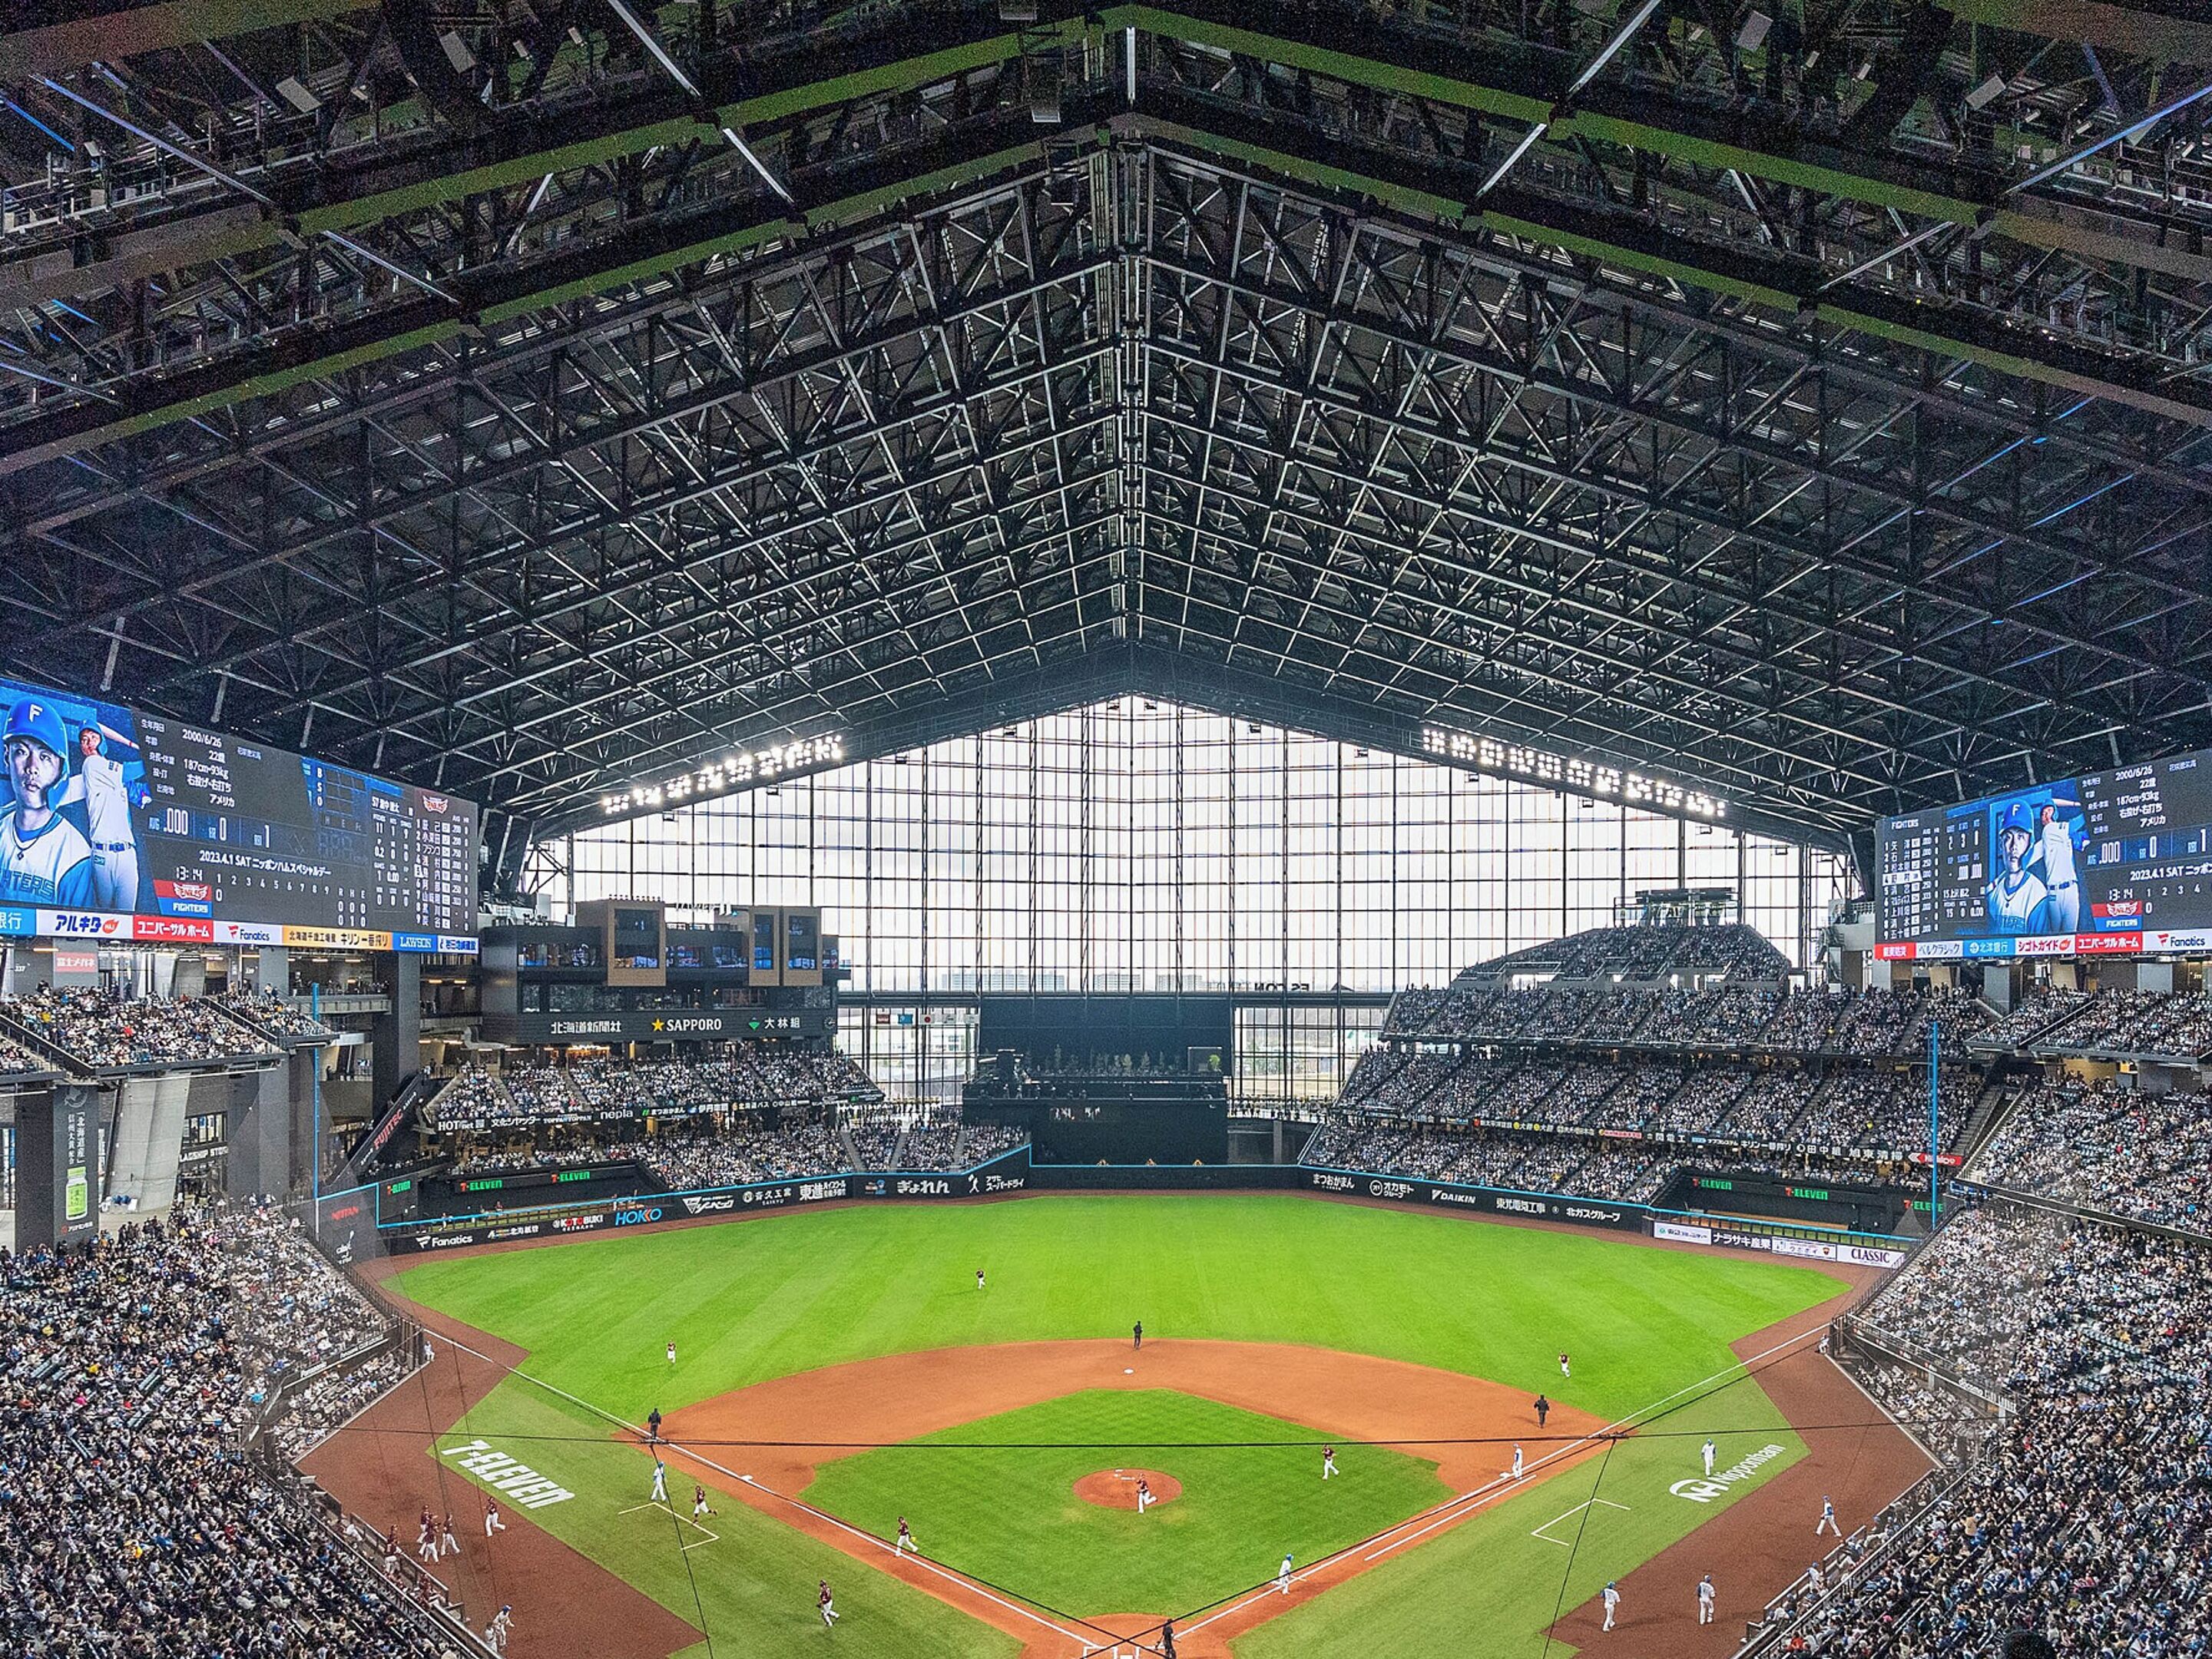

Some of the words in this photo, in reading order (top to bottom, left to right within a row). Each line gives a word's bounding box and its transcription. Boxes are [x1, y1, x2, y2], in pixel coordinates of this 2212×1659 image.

[28, 704, 42, 722] F
[182, 729, 222, 747] 2000/6/26
[317, 767, 323, 778] B
[317, 782, 322, 793] S
[209, 793, 235, 807] アメリカ
[2012, 804, 2021, 816] F
[219, 817, 227, 841] 0
[264, 824, 270, 848] 1
[2150, 836, 2157, 858] 0
[2200, 829, 2207, 852] 1
[199, 850, 233, 866] 2023.4.1
[235, 854, 251, 868] SAT
[2131, 868, 2164, 881] 2023.4.1
[2166, 866, 2184, 877] SAT
[217, 873, 221, 883] 1
[230, 876, 237, 886] 2
[246, 877, 251, 886] 3
[260, 879, 265, 888] 4
[273, 880, 279, 889] 5
[287, 882, 293, 891] 6
[300, 883, 305, 892] 7
[312, 885, 317, 893] 8
[324, 886, 329, 895] 9
[339, 888, 343, 897] R
[350, 889, 355, 898] H
[361, 890, 366, 899] E
[2147, 888, 2151, 897] 1
[2162, 886, 2167, 896] 2
[2178, 886, 2184, 895] 3
[2194, 884, 2200, 893] 4
[216, 889, 223, 902] 0
[339, 901, 343, 912] 0
[349, 902, 355, 913] 0
[360, 903, 366, 914] 0
[2146, 902, 2152, 914] 0
[173, 902, 209, 914] FIGHTERS
[338, 915, 343, 926] 0
[349, 916, 354, 927] 1
[360, 916, 366, 927] 0
[55, 915, 102, 933] アルキタ
[240, 929, 270, 942] Fanatics
[400, 935, 432, 949] LAWSON
[2171, 935, 2205, 948] Fanatics
[2018, 939, 2058, 952] シゴトガイド
[551, 1021, 621, 1034] 北海道新聞社
[666, 1018, 722, 1031] SAPPORO
[764, 1017, 801, 1029] 大林組
[373, 1108, 403, 1150] FUJITEC
[179, 1149, 208, 1163] LAGSHIP
[896, 1180, 950, 1194] ぎょれん
[985, 1178, 1025, 1191] スーパードライ
[1383, 1182, 1415, 1193] オカモト
[800, 1184, 823, 1201] 東進
[1383, 1190, 1404, 1199] グループ
[1440, 1193, 1476, 1204] DAIKIN
[560, 1214, 603, 1228] KOTOBUKI
[1566, 1207, 1621, 1223] 北ガスグループ
[432, 1234, 473, 1247] Fanatics
[1713, 1232, 1772, 1250] ナラサキ産業
[1851, 1248, 1890, 1263] CLASSIC
[1707, 1444, 1786, 1485] Nipponham
